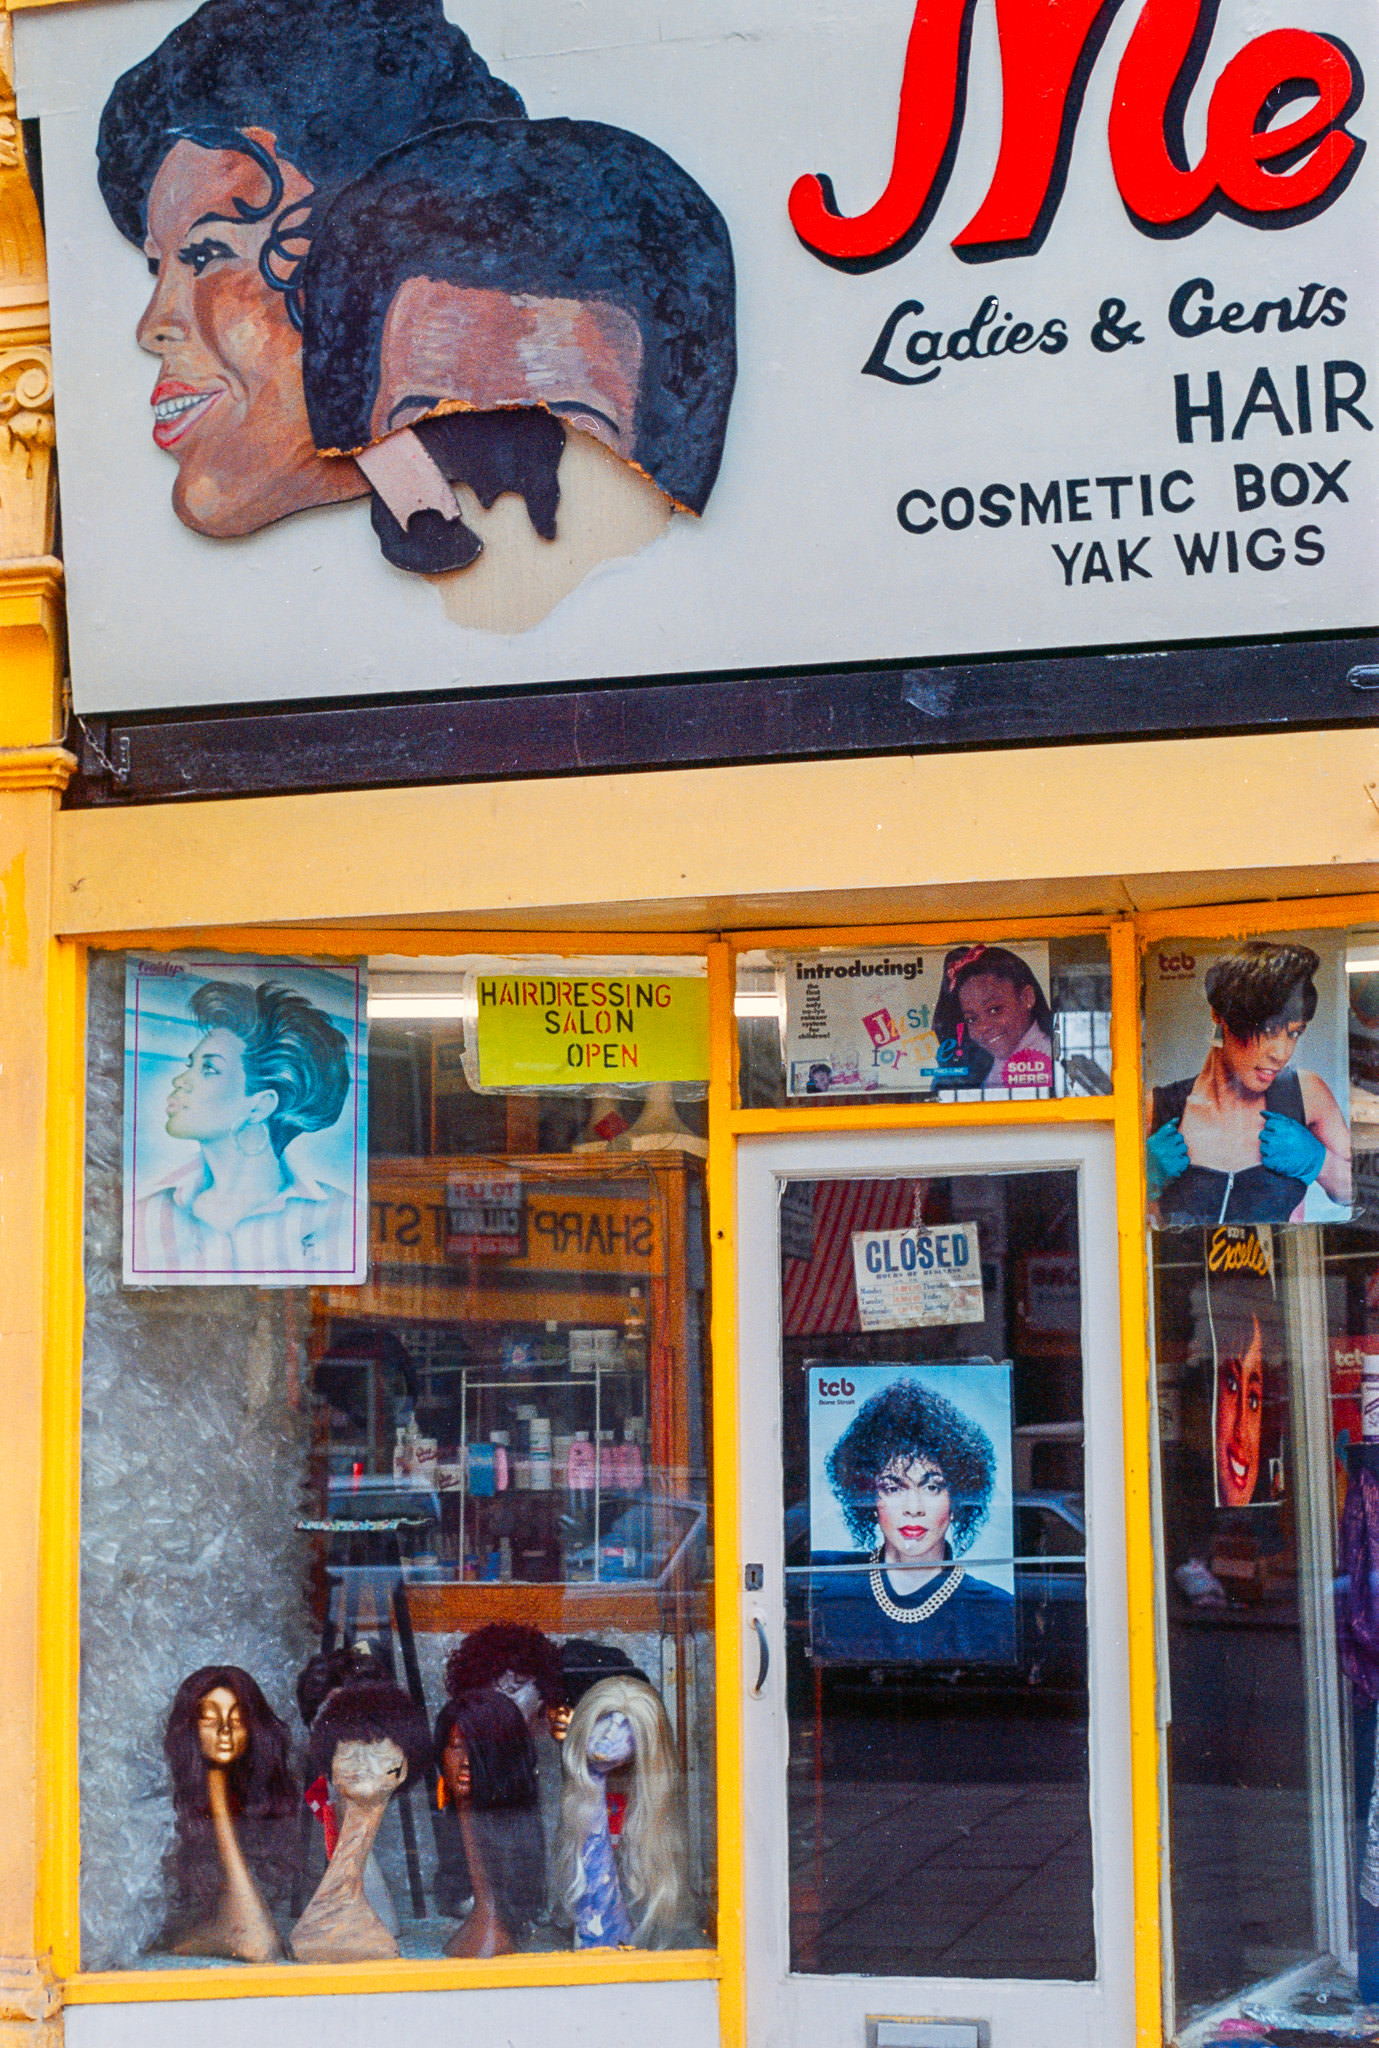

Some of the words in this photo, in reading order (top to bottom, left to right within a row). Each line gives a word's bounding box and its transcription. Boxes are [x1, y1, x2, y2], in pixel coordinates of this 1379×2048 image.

[861, 295, 1068, 385] Ladies
[1090, 298, 1145, 352] &
[1168, 277, 1348, 337] Gents
[1174, 360, 1374, 443] HAIR
[897, 469, 1195, 534] COSMETIC
[1234, 459, 1352, 511] BOX
[1052, 536, 1152, 586] YAK
[1174, 525, 1326, 576] WIGS
[796, 957, 923, 979] introducing!
[1159, 952, 1196, 971] tcb
[481, 982, 672, 1008] HAIRDRESSING
[545, 1009, 633, 1034] SALON
[568, 1043, 638, 1068] OPEN
[1008, 1061, 1045, 1073] SOLD
[866, 1233, 970, 1273] CLOSED
[818, 1377, 855, 1396] tcb
